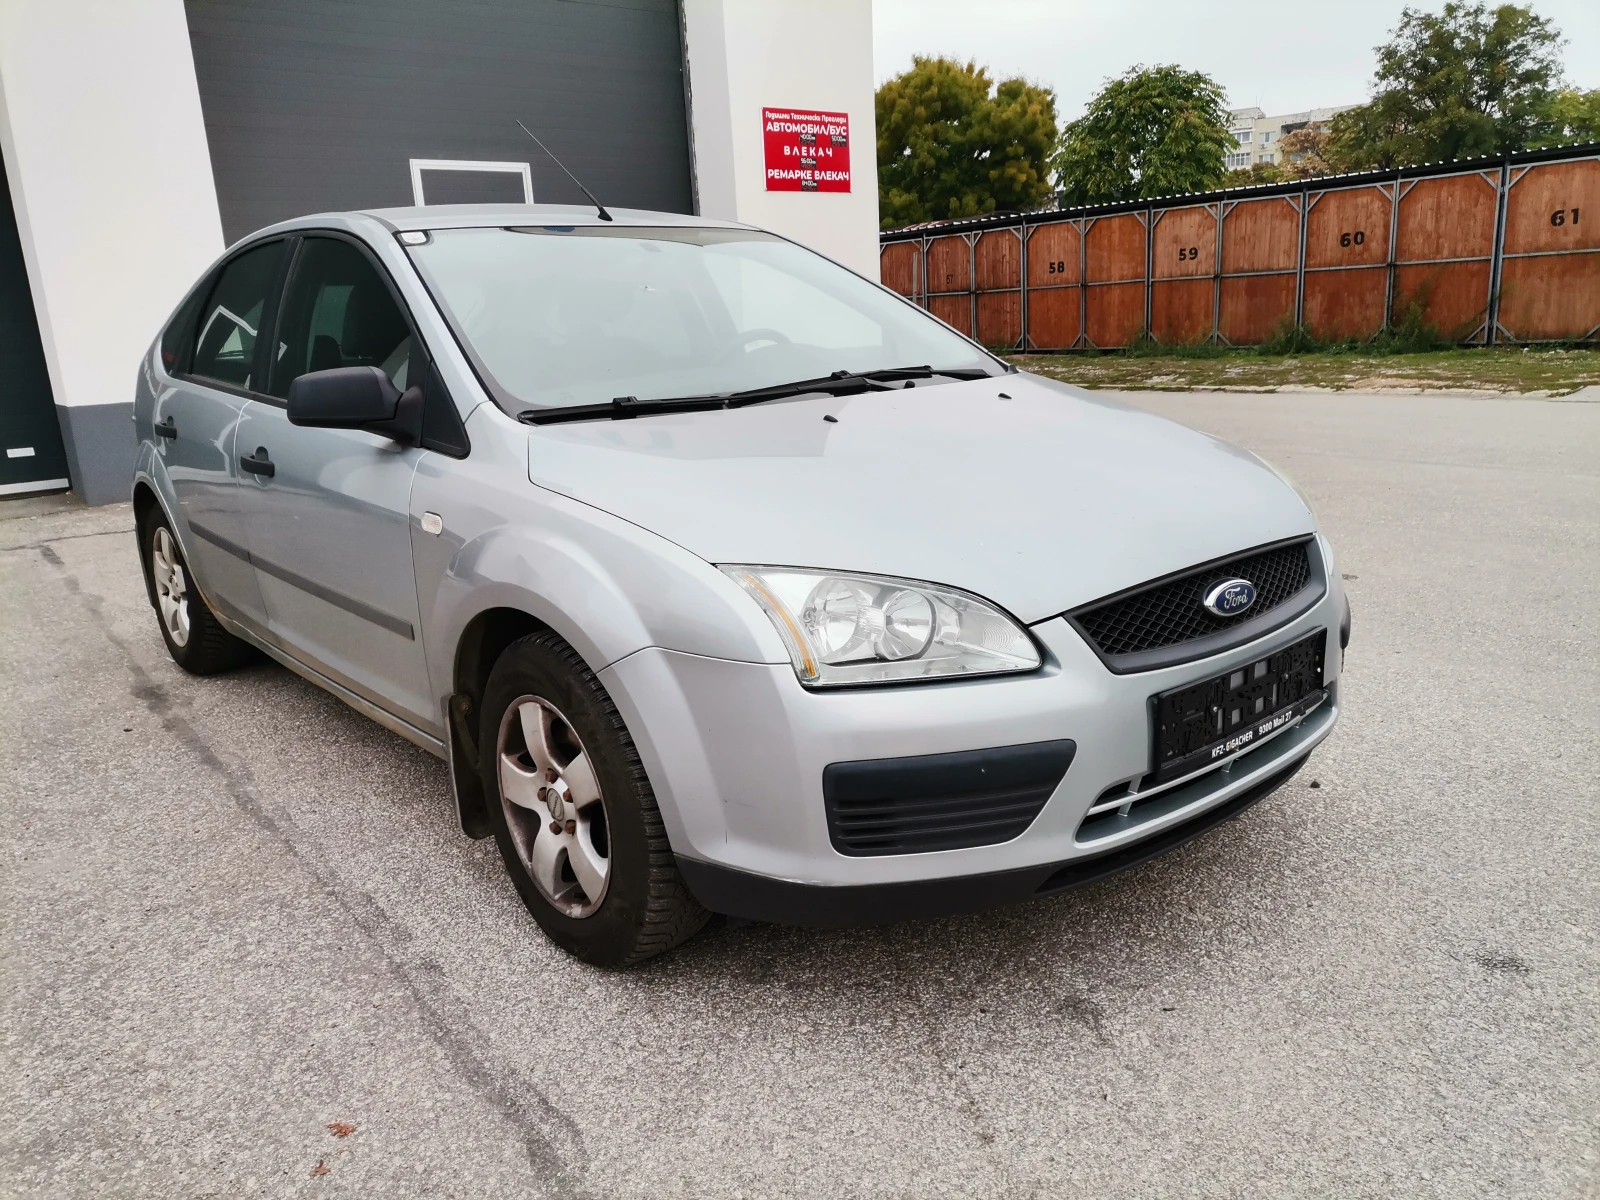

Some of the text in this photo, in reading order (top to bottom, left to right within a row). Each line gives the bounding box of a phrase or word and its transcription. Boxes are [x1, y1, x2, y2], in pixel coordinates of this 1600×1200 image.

[765, 111, 847, 124] Годишни Технически Прегледи
[766, 122, 847, 135] АВТОМОБИЛ/БУС
[767, 168, 849, 181] РЕМАРКЕ ВЛЕКАЧ
[1550, 208, 1580, 227] 61
[1339, 230, 1365, 248] 60
[1178, 247, 1199, 261] 59
[1048, 261, 1065, 274] 58
[1224, 587, 1249, 609] Ford
[1258, 721, 1273, 735] 9300
[1285, 710, 1293, 721] 27
